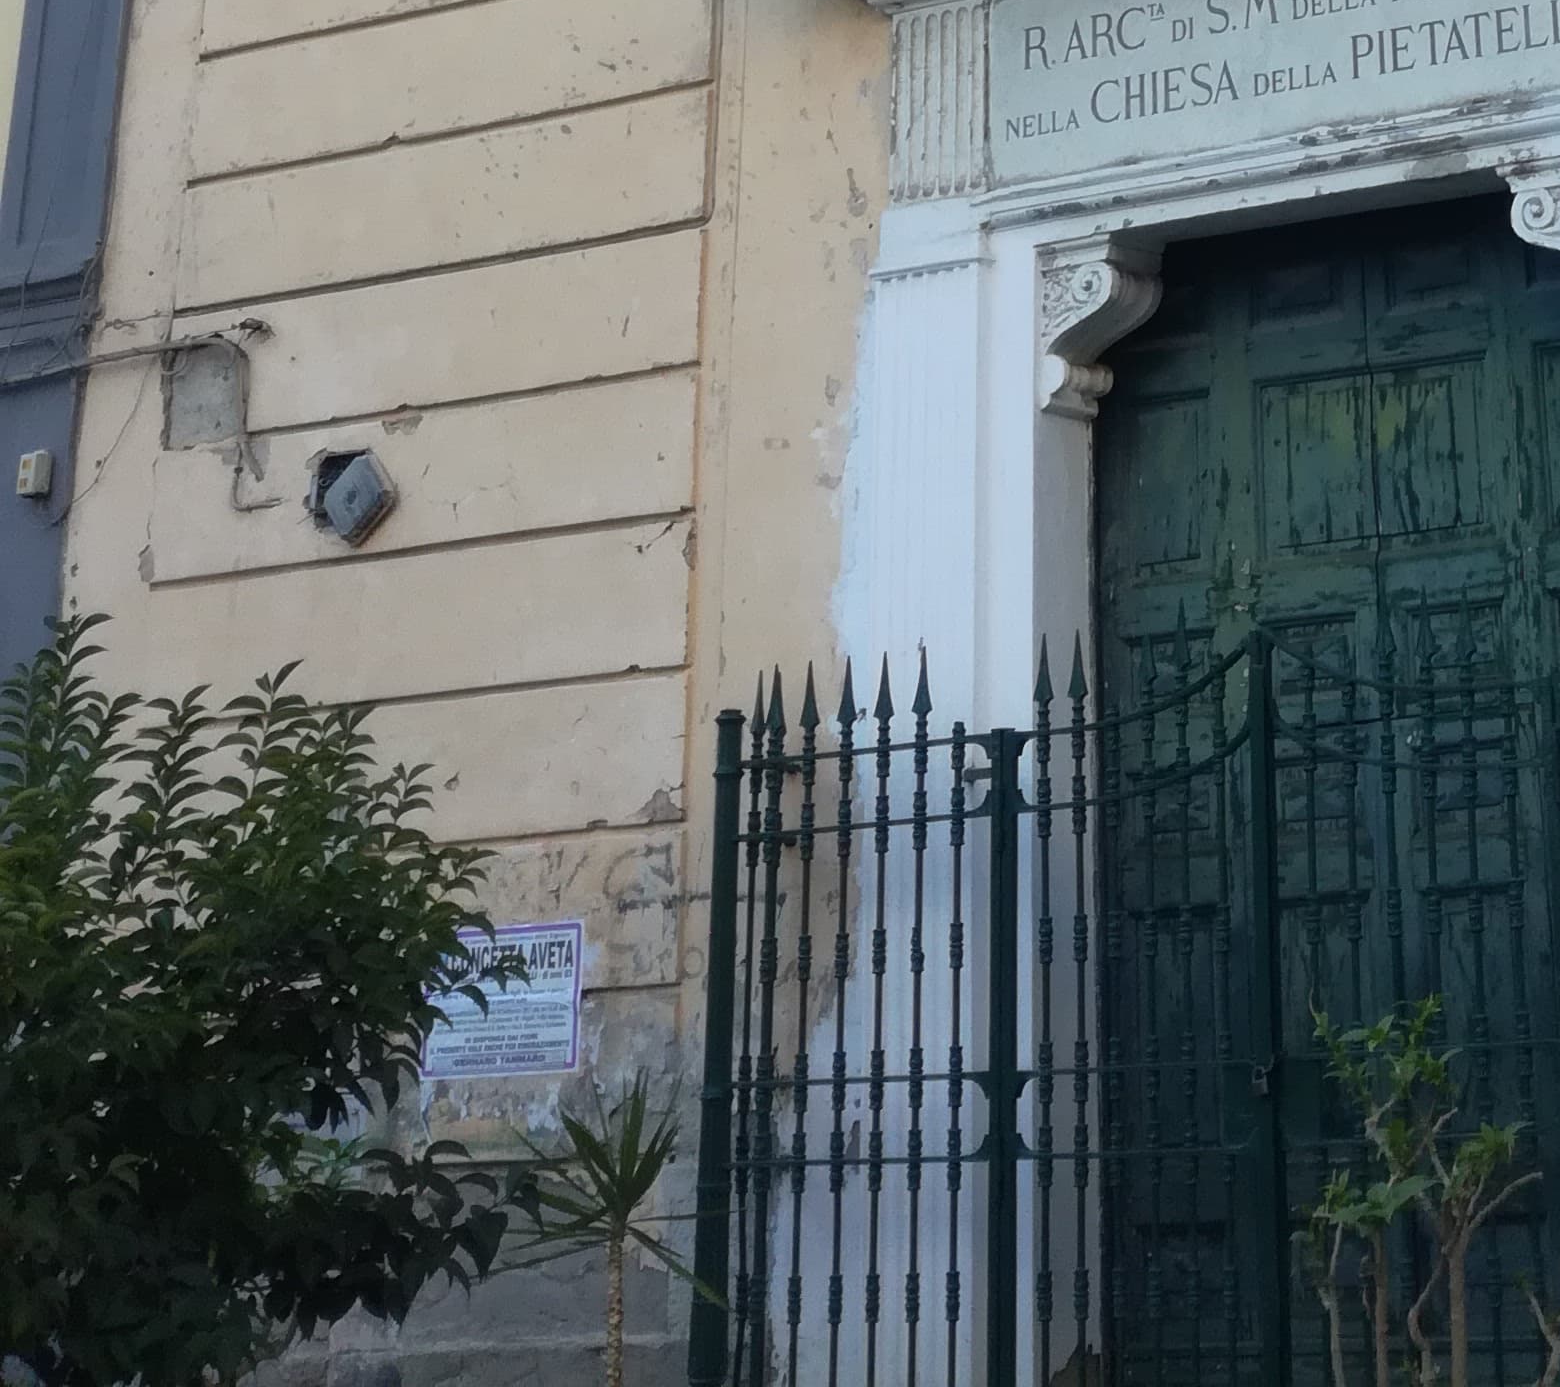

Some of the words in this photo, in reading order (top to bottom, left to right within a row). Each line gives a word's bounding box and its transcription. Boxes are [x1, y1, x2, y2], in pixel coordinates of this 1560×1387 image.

[1171, 16, 1195, 43] DI
[1005, 107, 1080, 142] NELLA
[1090, 59, 1239, 125] CHIESA
[1253, 61, 1338, 97] DELLA
[528, 940, 574, 970] AVETA
